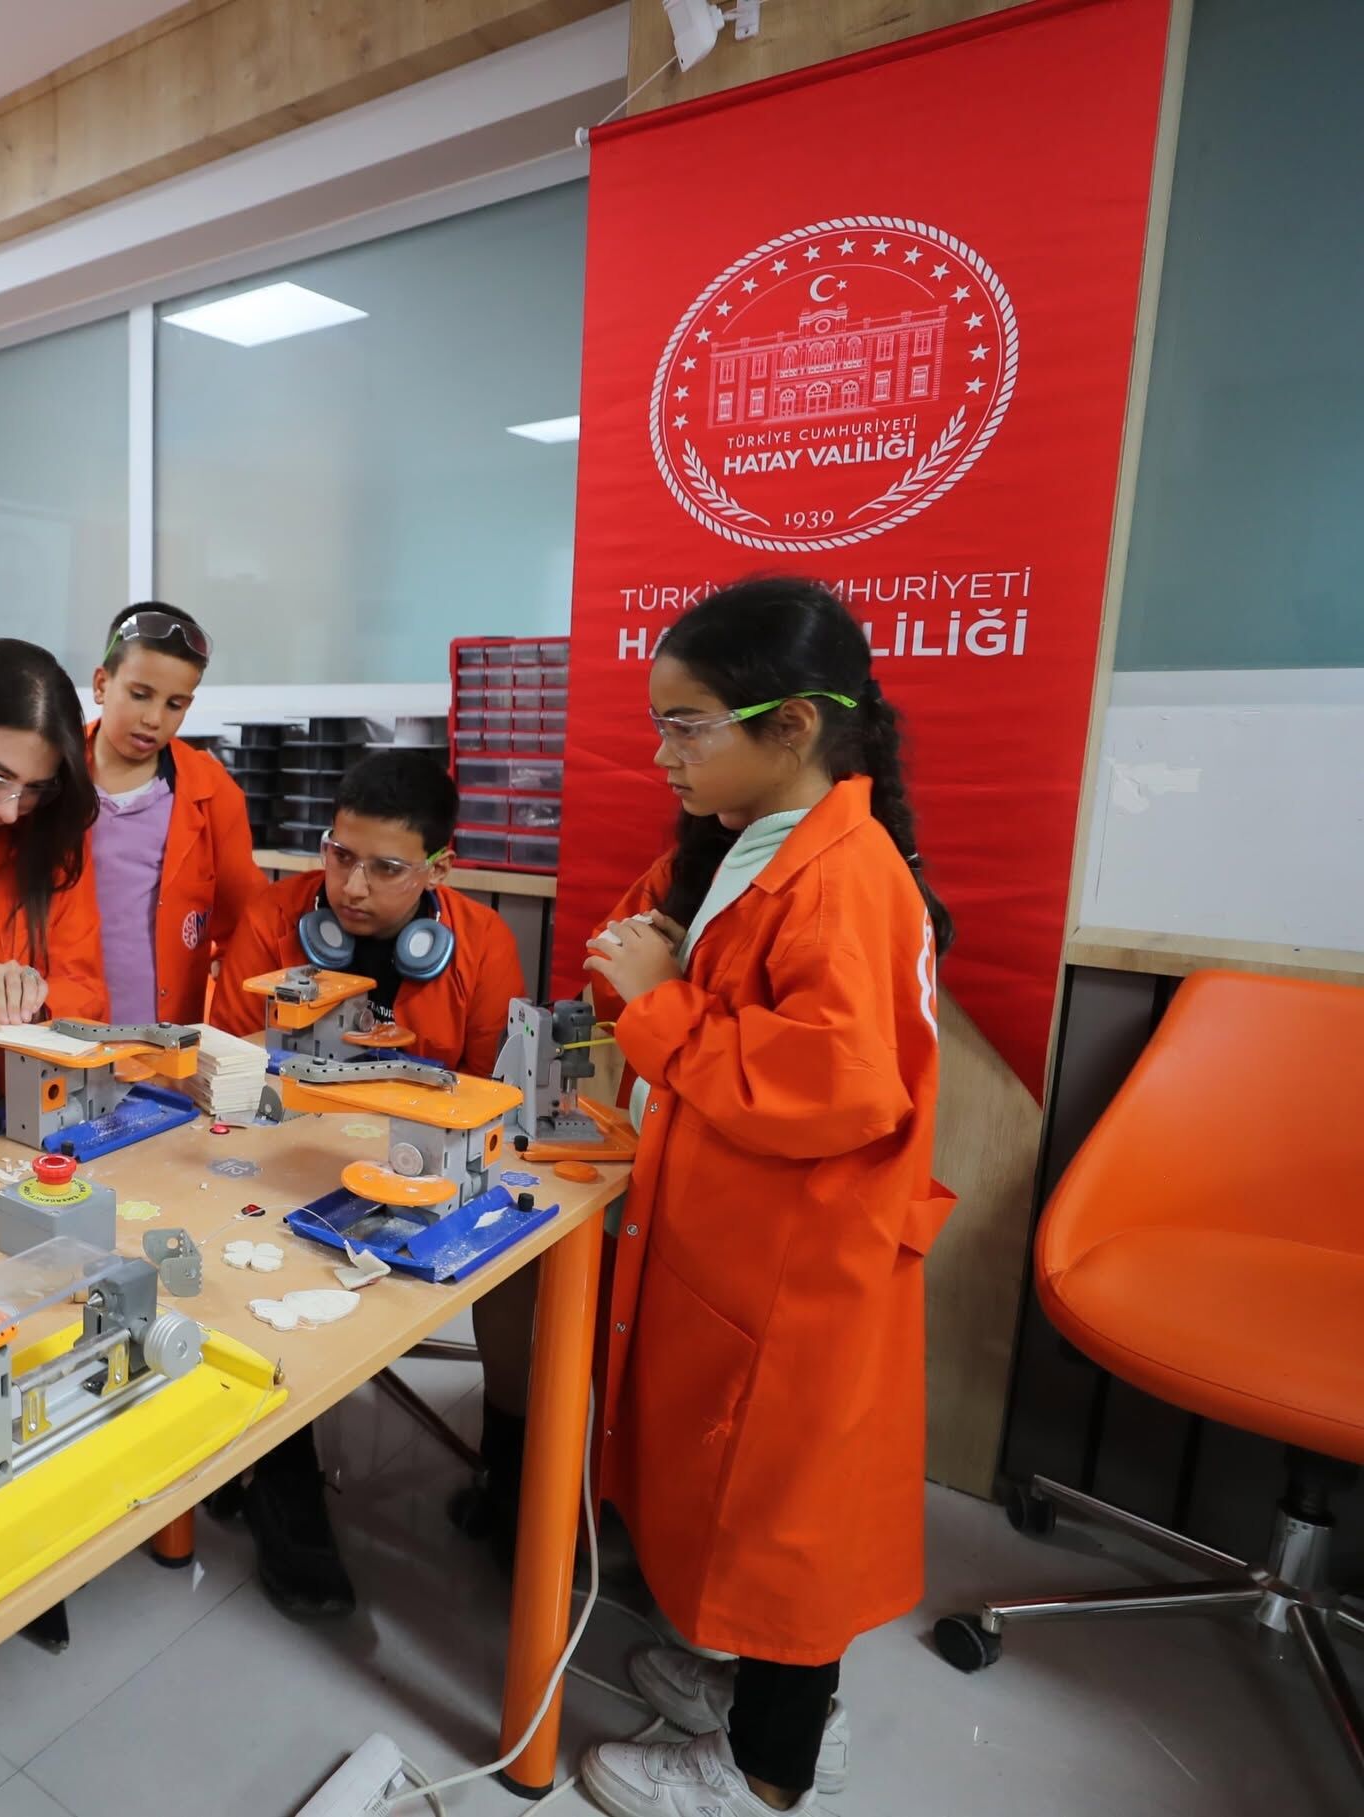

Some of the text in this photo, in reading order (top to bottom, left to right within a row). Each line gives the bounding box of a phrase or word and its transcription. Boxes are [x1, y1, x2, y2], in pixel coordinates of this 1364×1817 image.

[723, 431, 916, 476] HATAY VALİLİĞİ
[727, 414, 917, 449] TÜRKİYE CUMHURİYETİ
[784, 509, 835, 530] 1939
[620, 567, 1031, 612] TÜRKİ MHURİYETİ
[862, 608, 1028, 657] LİLİĞİ
